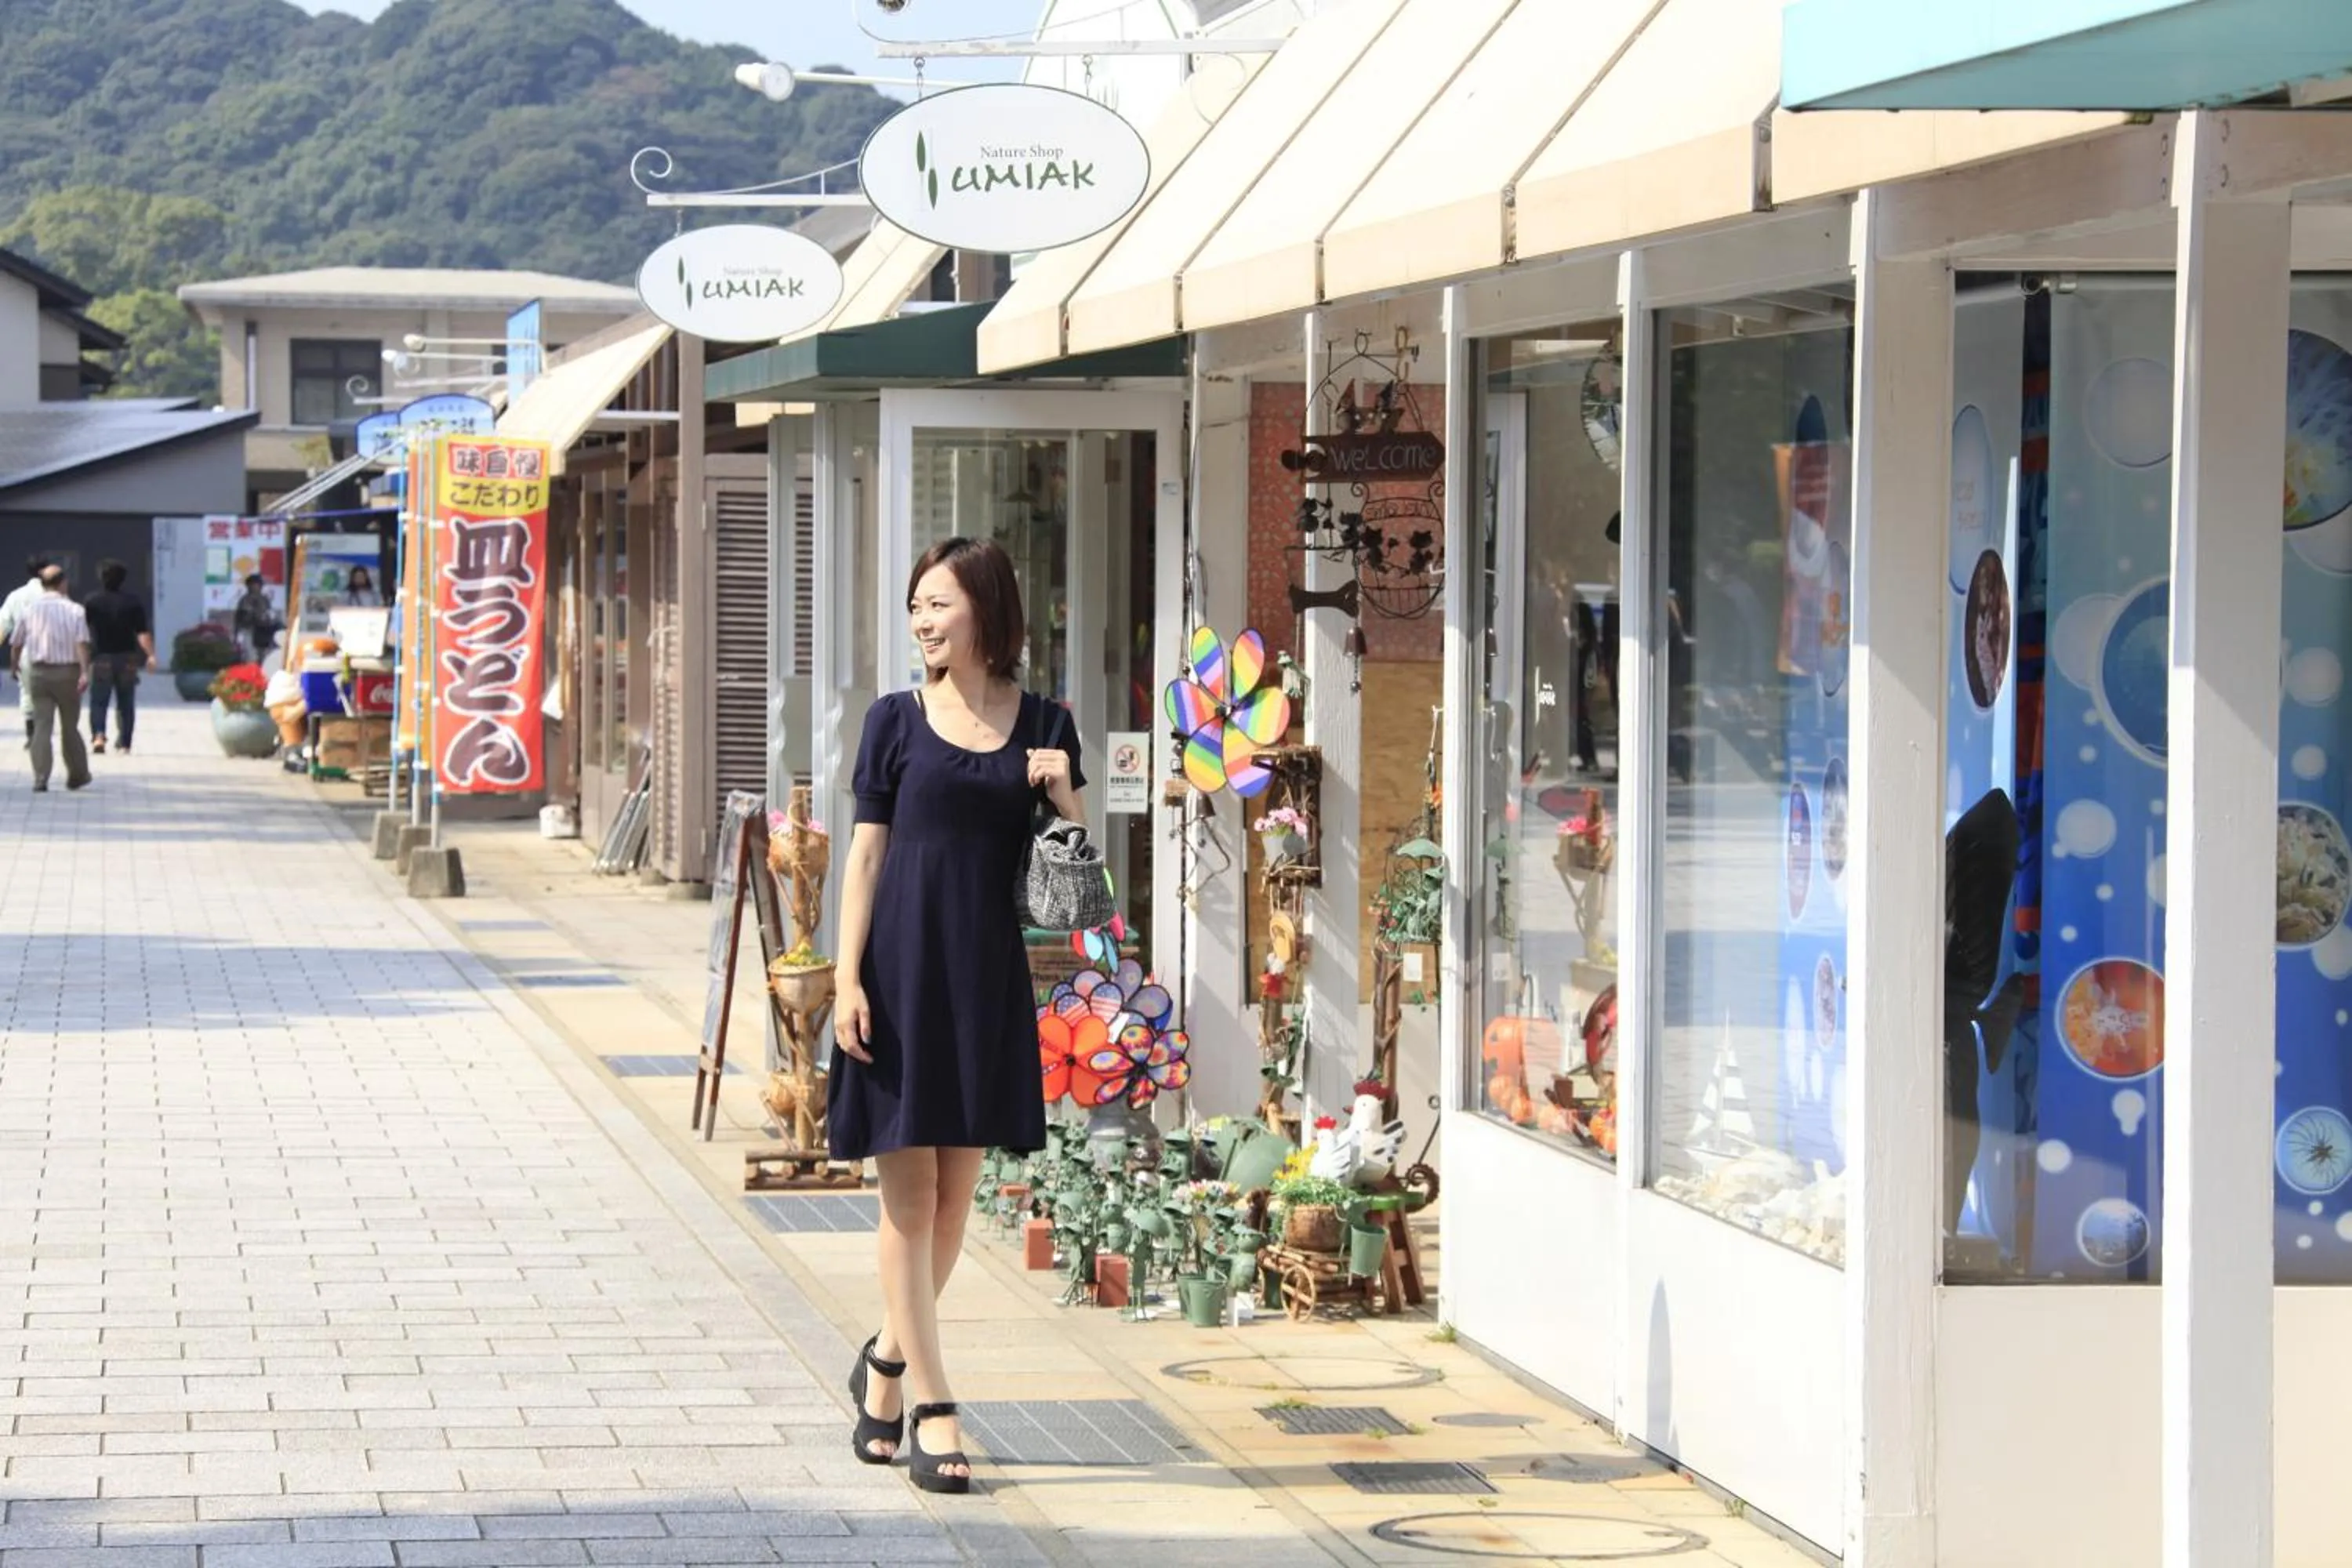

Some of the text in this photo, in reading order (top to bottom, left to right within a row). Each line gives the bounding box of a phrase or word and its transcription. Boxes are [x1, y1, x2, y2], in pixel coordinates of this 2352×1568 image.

[980, 143, 1064, 161] Nature Shop
[951, 159, 1095, 193] UMIAK
[722, 265, 783, 277] Nature Shop
[702, 277, 804, 299] UMIAK
[450, 481, 539, 509] こだわり
[443, 517, 534, 786] 皿うどん
